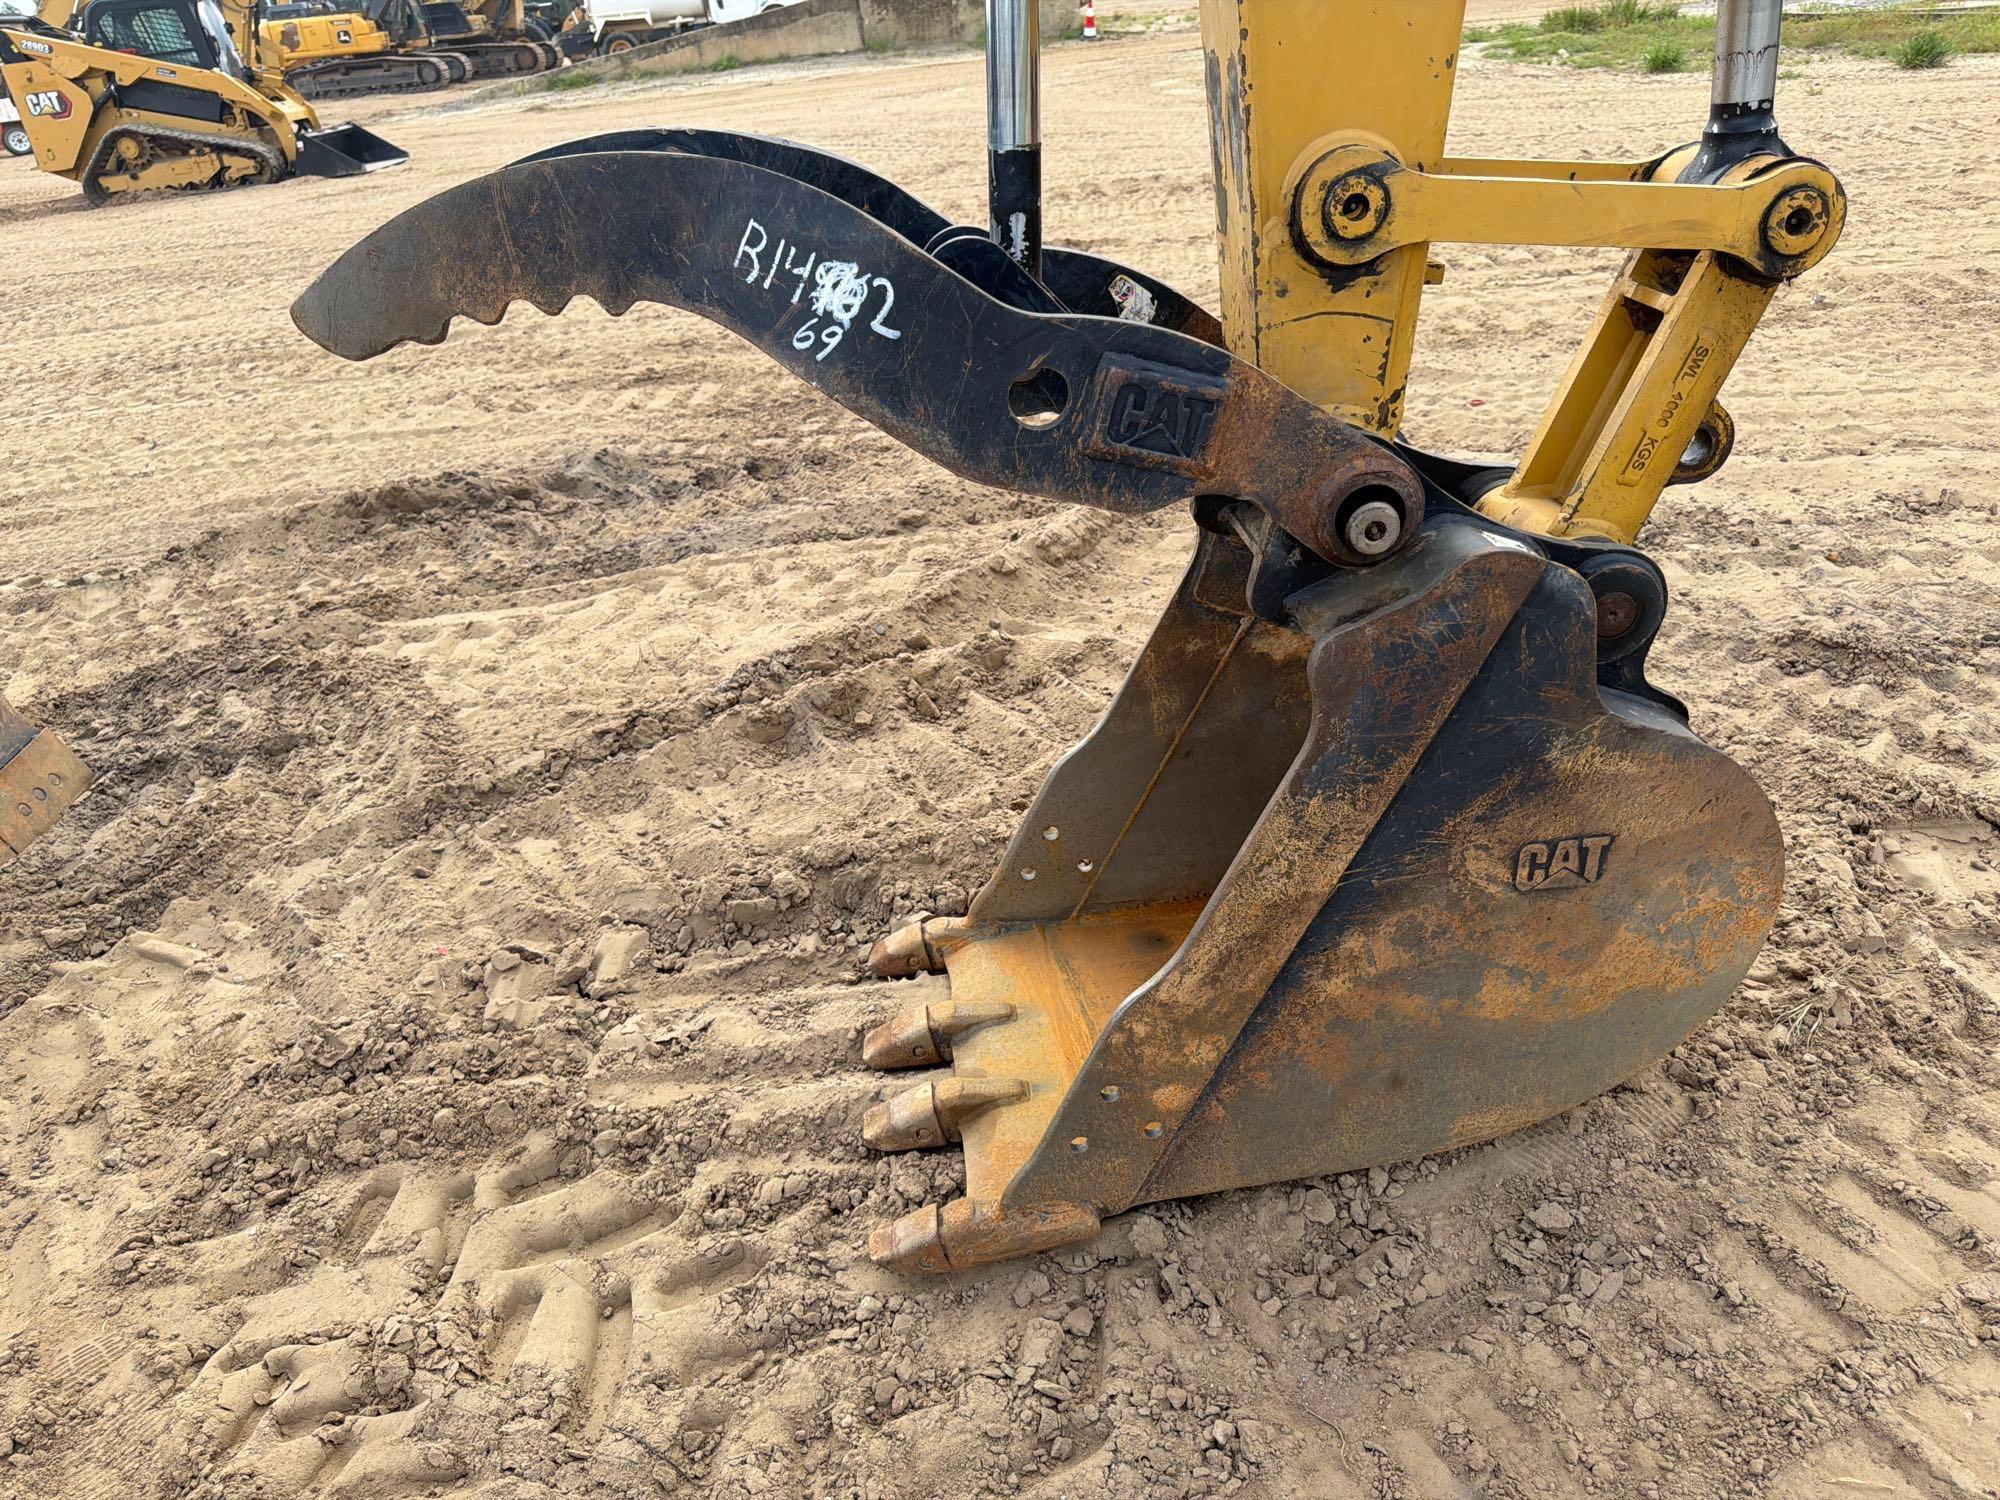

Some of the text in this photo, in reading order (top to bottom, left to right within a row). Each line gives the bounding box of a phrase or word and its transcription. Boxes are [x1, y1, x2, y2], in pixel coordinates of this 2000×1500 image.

[25, 91, 62, 116] CAT
[1681, 345, 1709, 380] SWL
[1107, 382, 1217, 458] CAT
[1632, 436, 1659, 471] KGS
[1514, 835, 1612, 893] CAT
